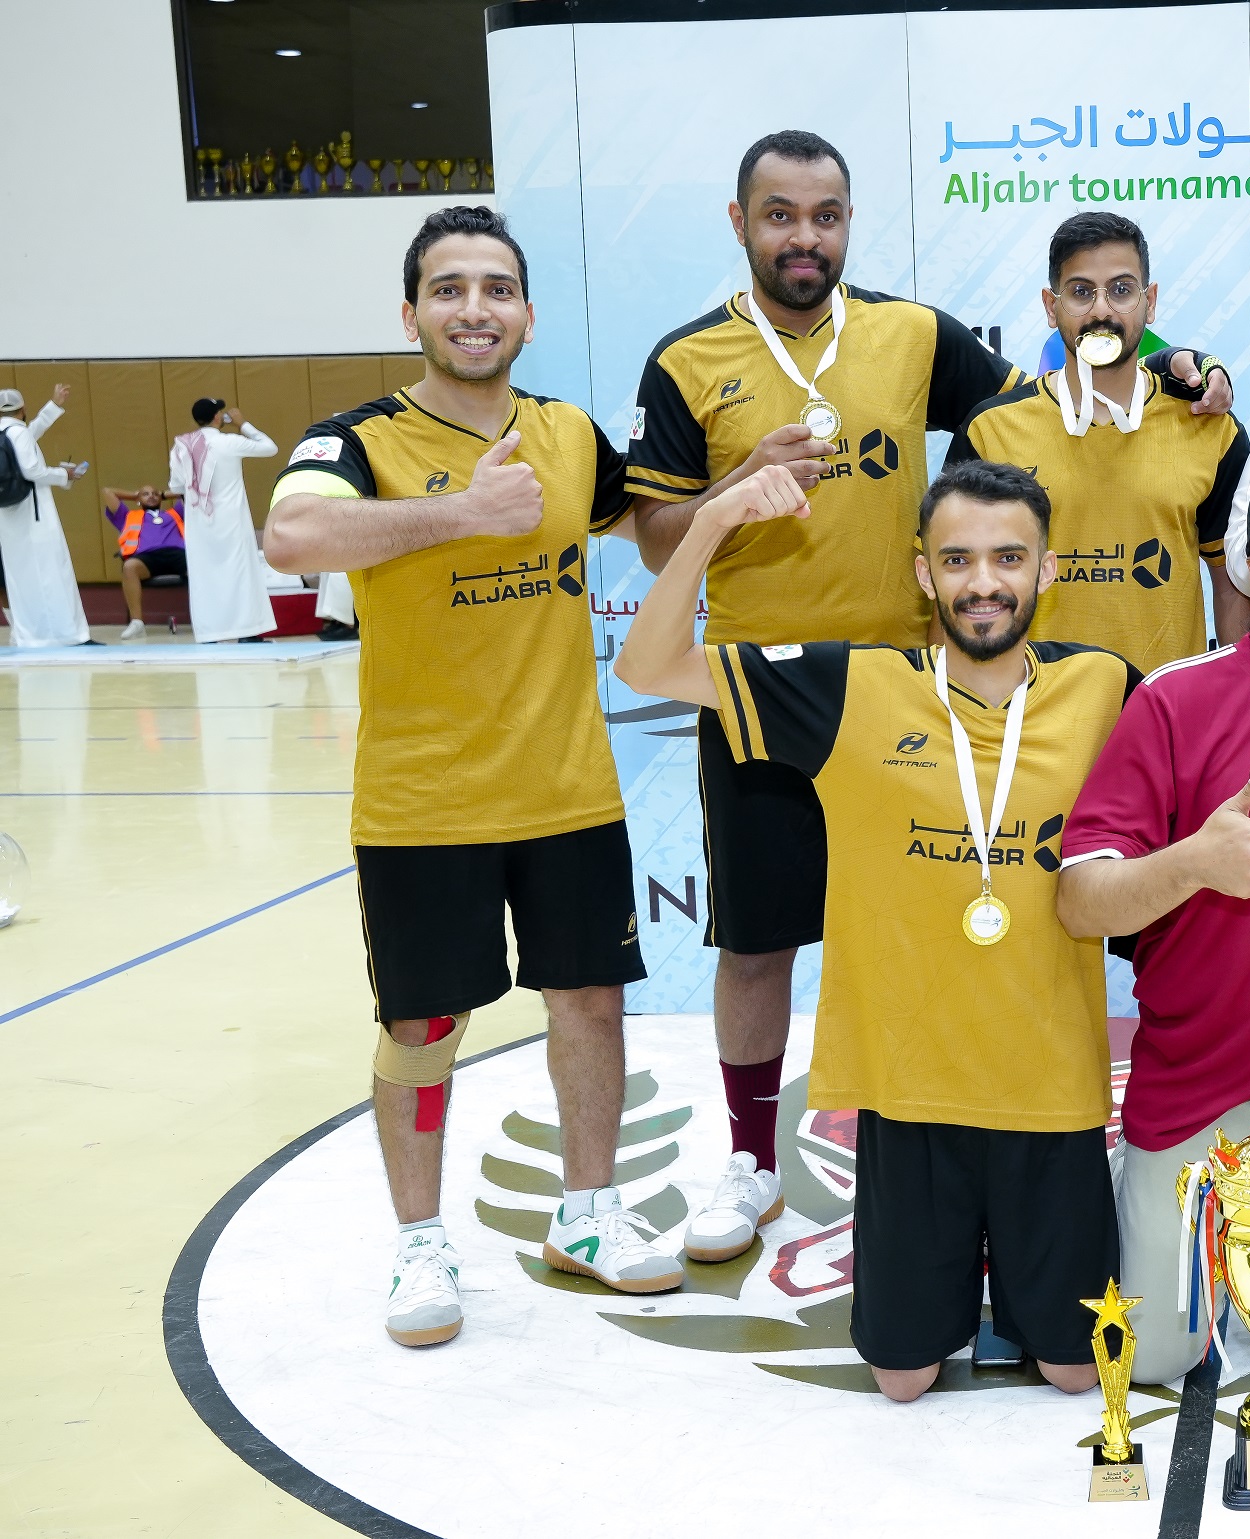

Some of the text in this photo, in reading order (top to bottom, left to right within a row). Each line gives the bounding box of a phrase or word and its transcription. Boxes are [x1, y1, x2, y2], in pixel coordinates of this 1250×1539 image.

[939, 104, 1098, 164] الجبر
[943, 170, 1060, 213] Aljabr
[712, 394, 756, 415] HATTRICK
[1056, 543, 1125, 565] الجب
[450, 553, 549, 586] الجبر
[1054, 567, 1125, 583] JABR
[450, 579, 552, 608] ALJABR
[882, 758, 938, 768] HATTRICK
[906, 839, 1025, 866] ALJABR
